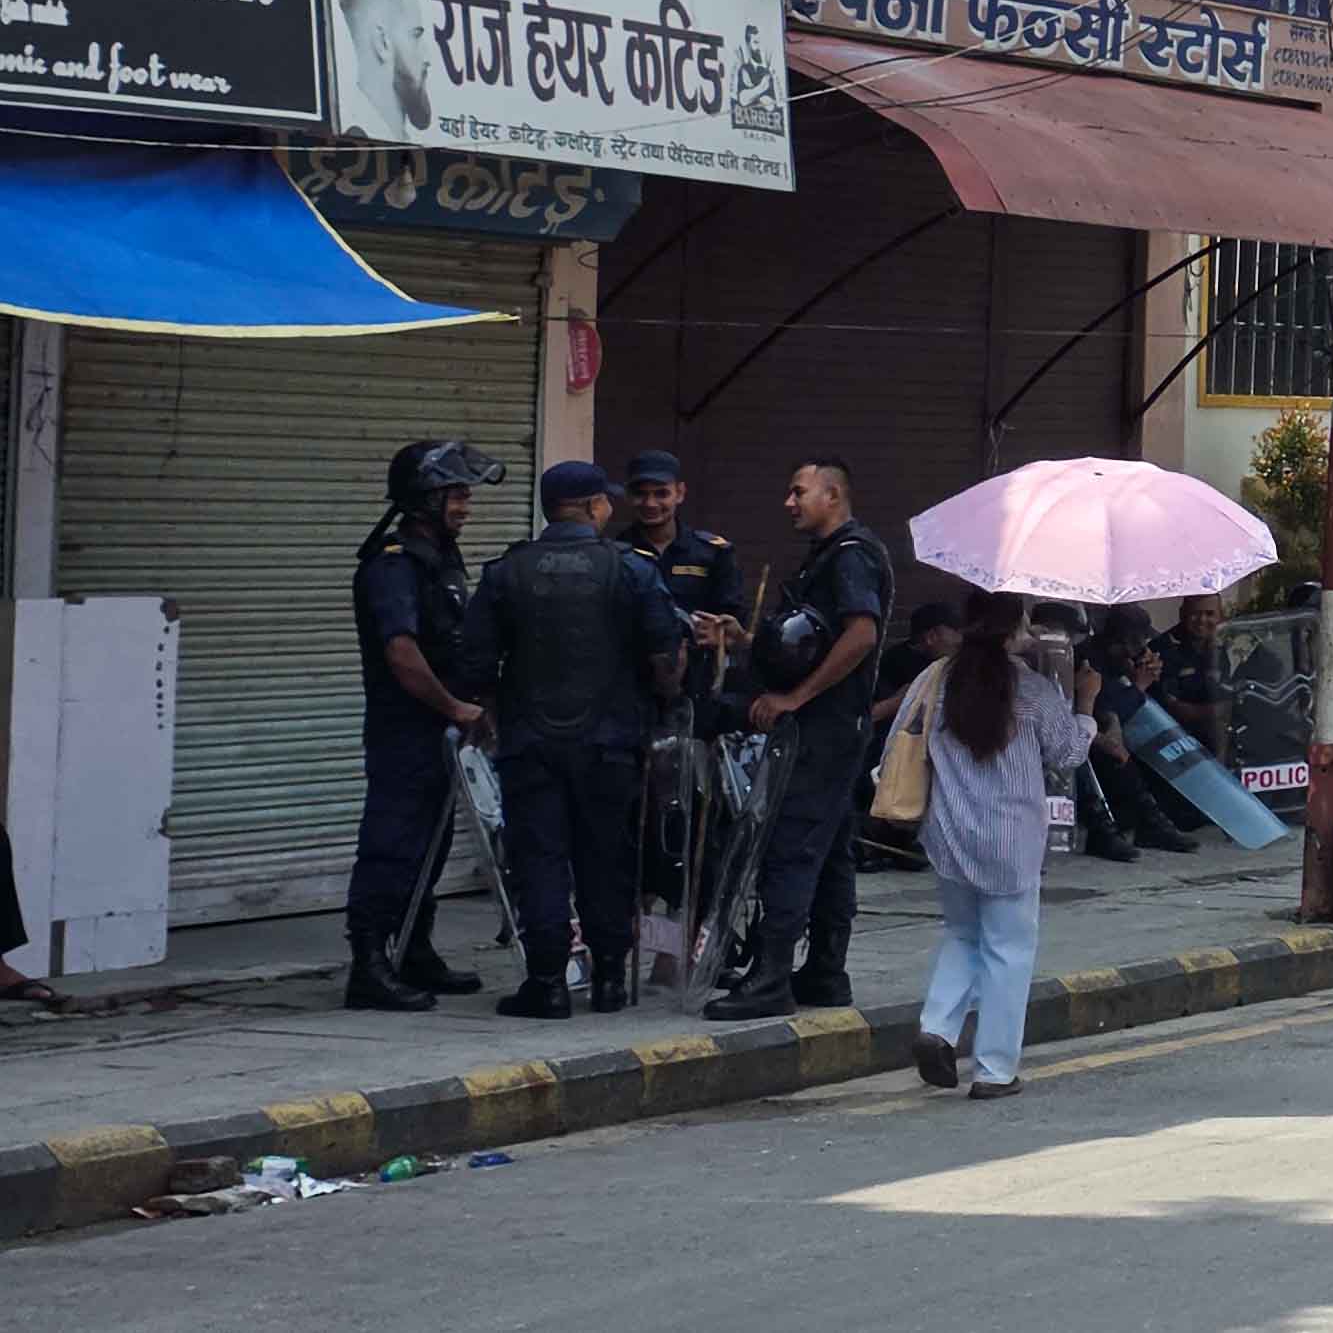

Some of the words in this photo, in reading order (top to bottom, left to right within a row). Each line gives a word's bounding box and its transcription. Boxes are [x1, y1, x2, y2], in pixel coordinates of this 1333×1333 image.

[52, 41, 105, 81] and
[108, 41, 167, 95] foot
[169, 70, 232, 95] wear
[1138, 7, 1270, 89] स्टोर्स
[734, 107, 783, 133] BARBER
[468, 115, 502, 140] हेयर
[640, 141, 665, 160] तथा
[667, 141, 714, 168] फेसियल
[717, 149, 739, 171] पनि
[1244, 765, 1307, 788] POLIC
[1050, 800, 1074, 822] LICE
